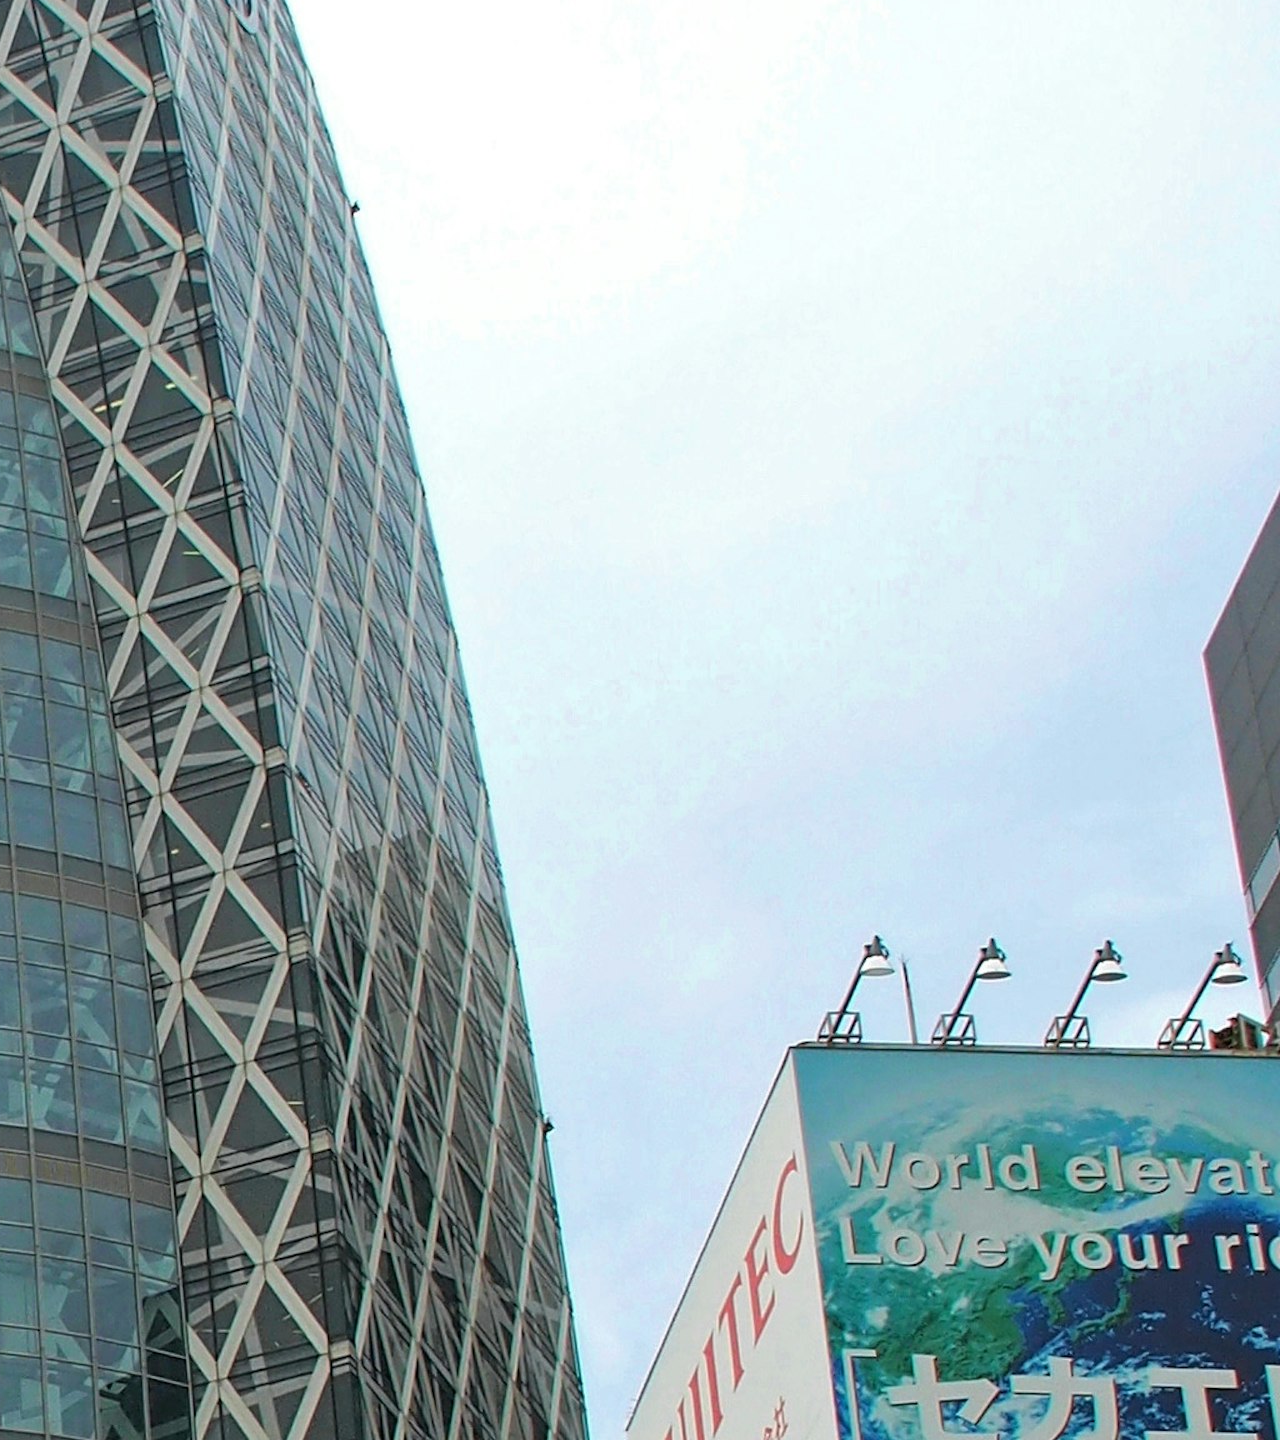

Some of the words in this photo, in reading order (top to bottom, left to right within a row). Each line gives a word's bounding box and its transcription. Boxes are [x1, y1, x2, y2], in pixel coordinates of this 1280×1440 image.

[830, 1141, 1041, 1192] World
[1065, 1145, 1280, 1196] elevat
[840, 1217, 1009, 1268] Love
[1032, 1228, 1190, 1281] your
[1216, 1224, 1280, 1271] ri
